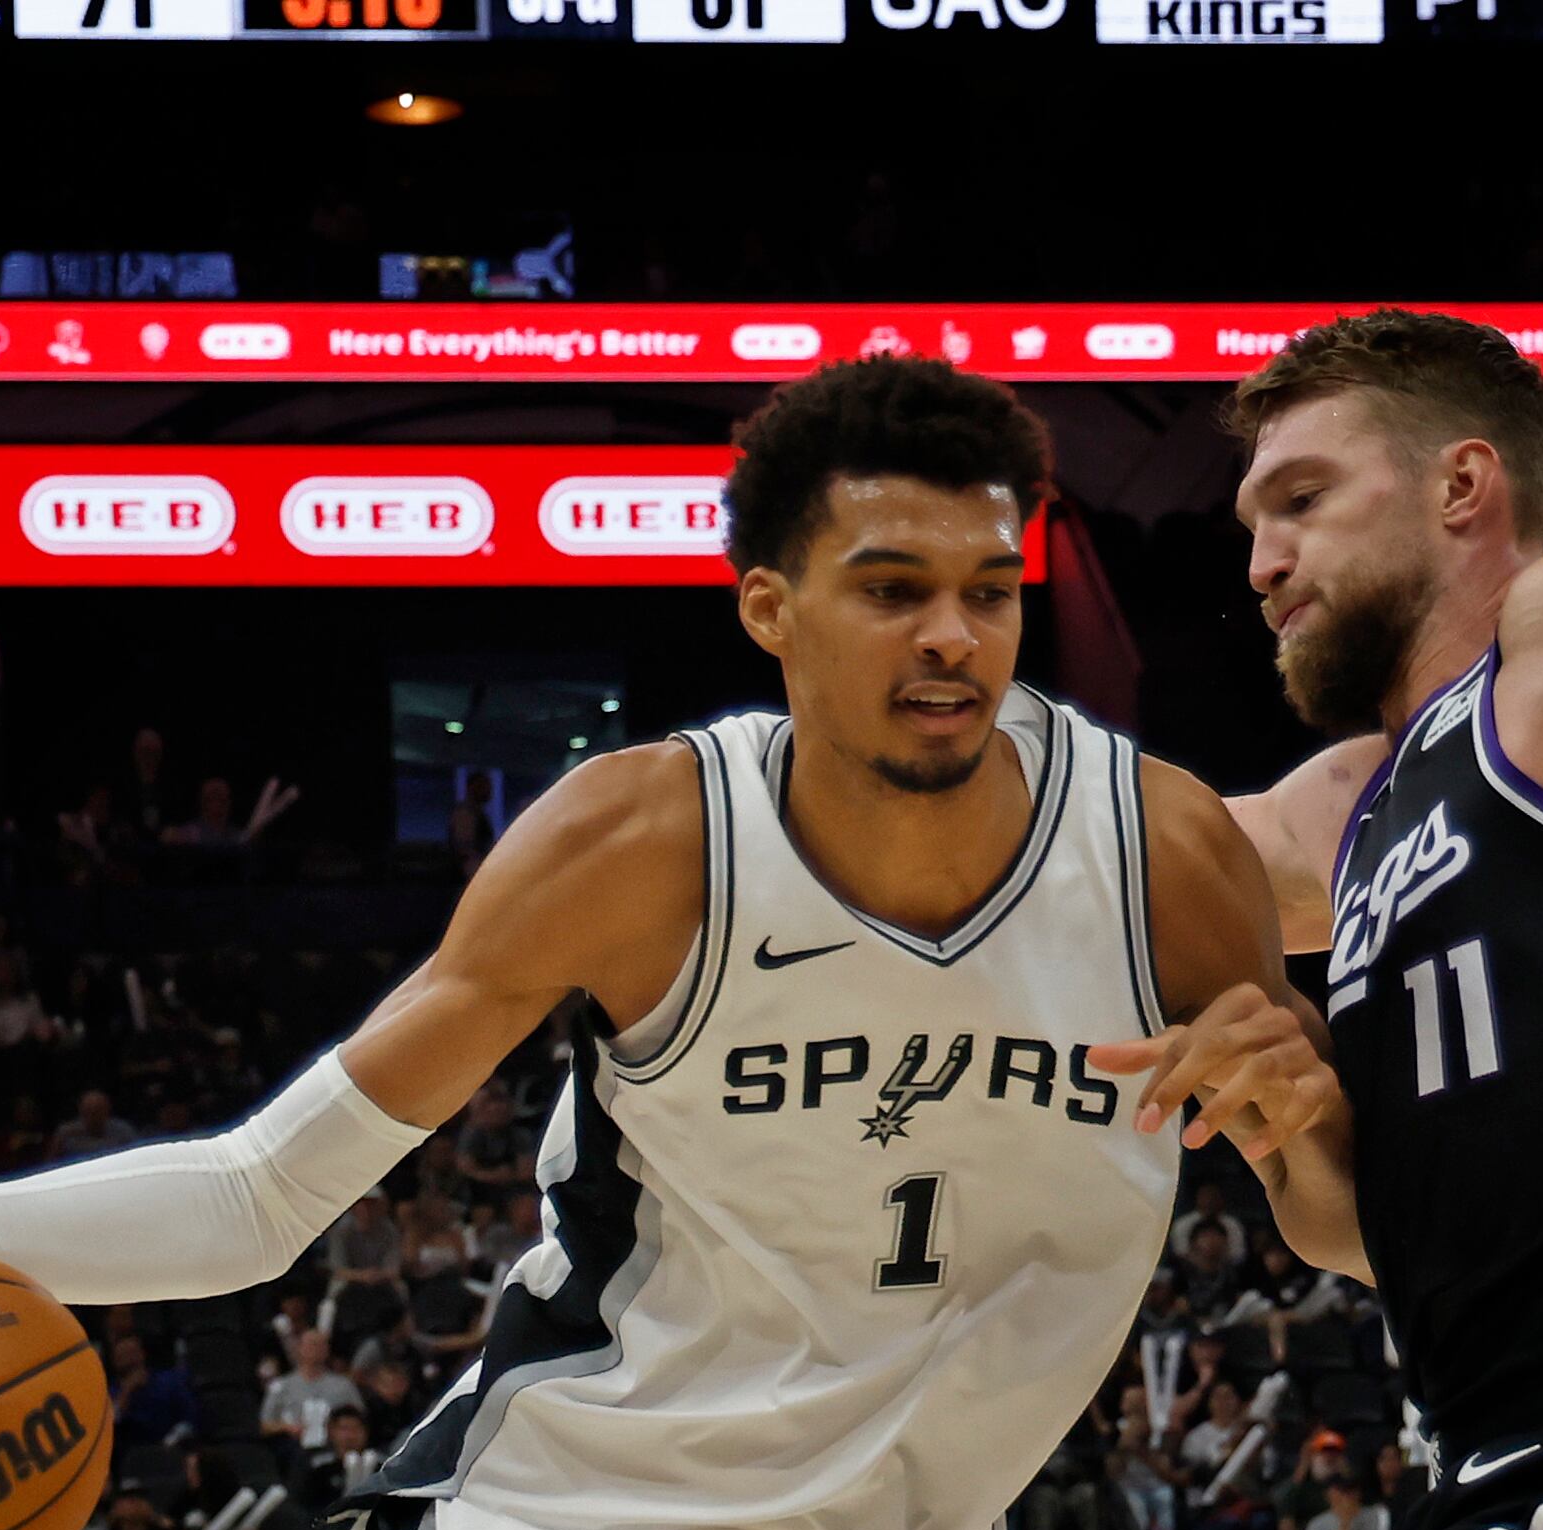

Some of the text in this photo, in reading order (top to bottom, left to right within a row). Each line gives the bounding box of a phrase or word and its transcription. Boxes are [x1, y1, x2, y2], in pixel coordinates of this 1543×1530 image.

[1149, 0, 1326, 35] KINGS
[330, 328, 698, 361] Here Everything's Better
[1403, 939, 1498, 1097] 11
[722, 1034, 1119, 1142] SPURS
[872, 1171, 948, 1293] 1
